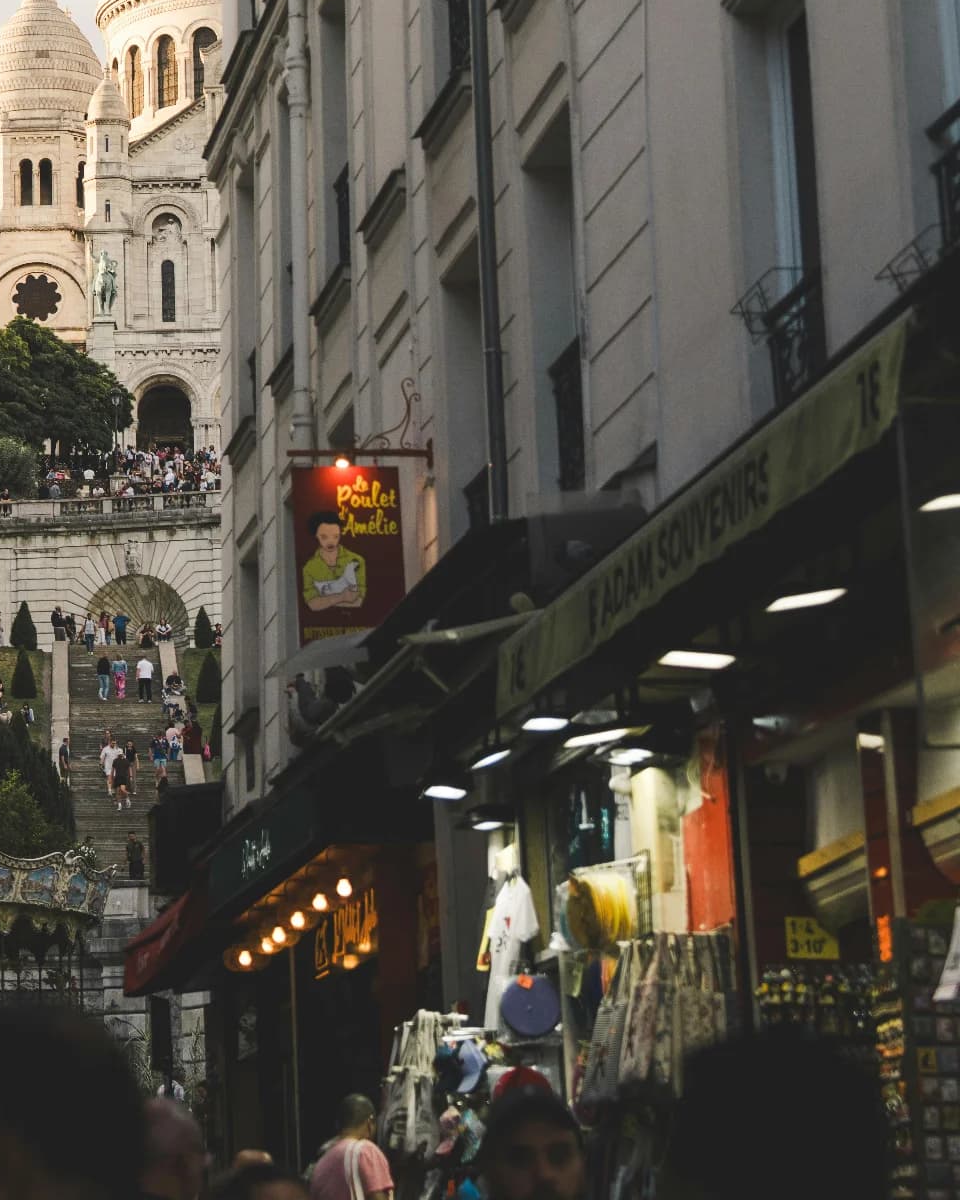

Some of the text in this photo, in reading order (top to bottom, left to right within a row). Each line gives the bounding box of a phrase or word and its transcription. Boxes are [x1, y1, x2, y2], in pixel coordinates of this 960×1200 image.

[336, 480, 397, 508] Poulet
[601, 539, 654, 628] ADAM
[656, 449, 770, 580] SOUVENIRS
